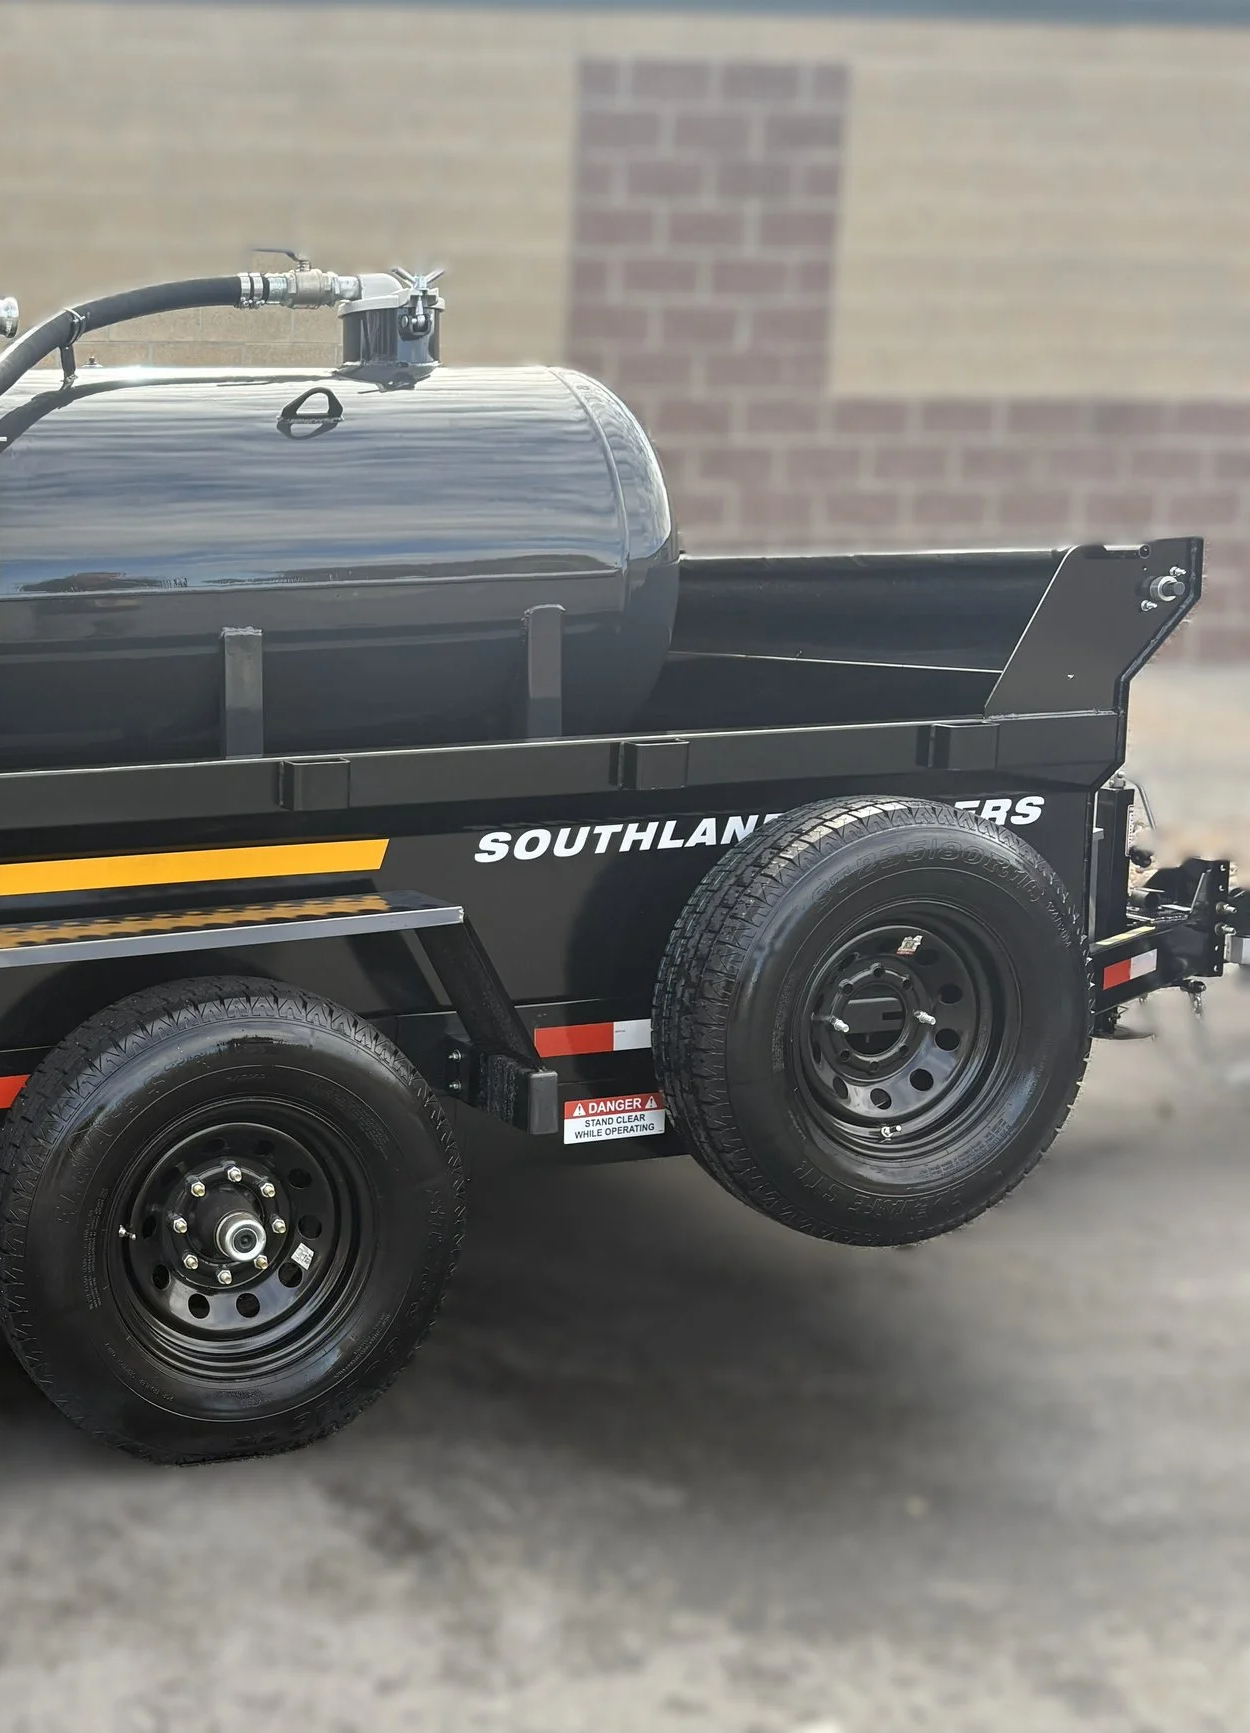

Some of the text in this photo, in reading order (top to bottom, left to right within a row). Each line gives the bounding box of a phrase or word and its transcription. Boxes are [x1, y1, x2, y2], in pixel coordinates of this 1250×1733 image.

[588, 1098, 642, 1114] DANGER
[584, 1114, 645, 1128] STAND CLEAR
[575, 1123, 655, 1140] WHILE OPERATING
